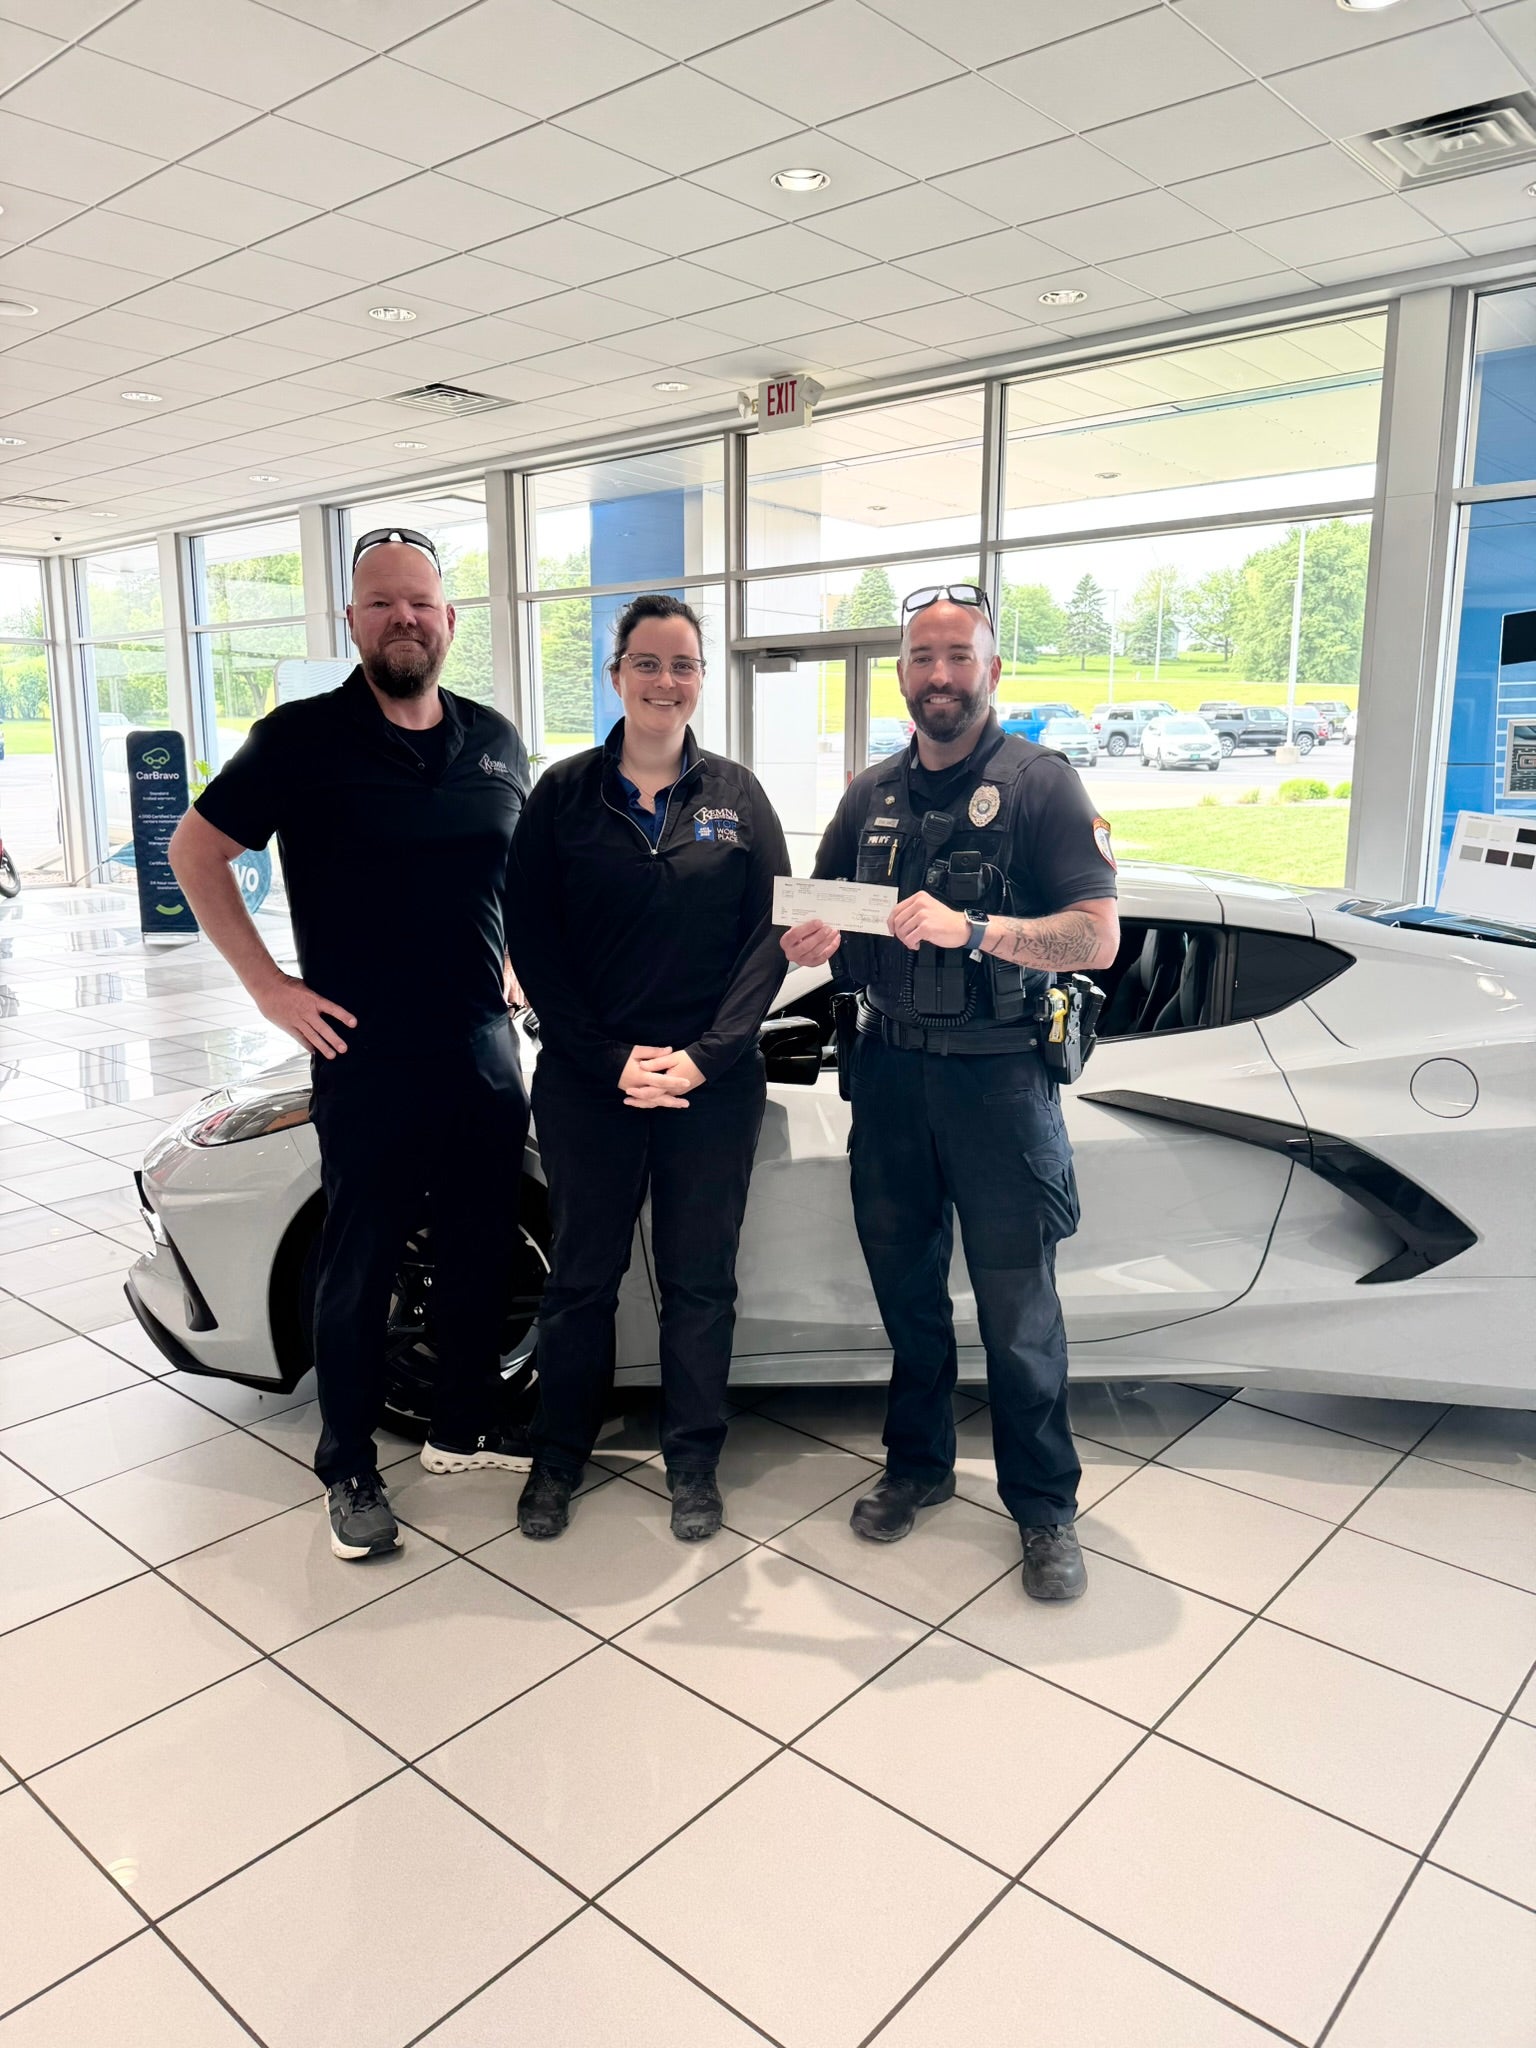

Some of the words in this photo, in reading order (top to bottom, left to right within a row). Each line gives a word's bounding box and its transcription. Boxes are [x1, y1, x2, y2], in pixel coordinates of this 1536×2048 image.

[767, 380, 797, 416] EXIT
[135, 771, 180, 781] CarBravo
[715, 820, 737, 829] TOP
[716, 827, 737, 837] WORK
[717, 834, 739, 843] PLACE
